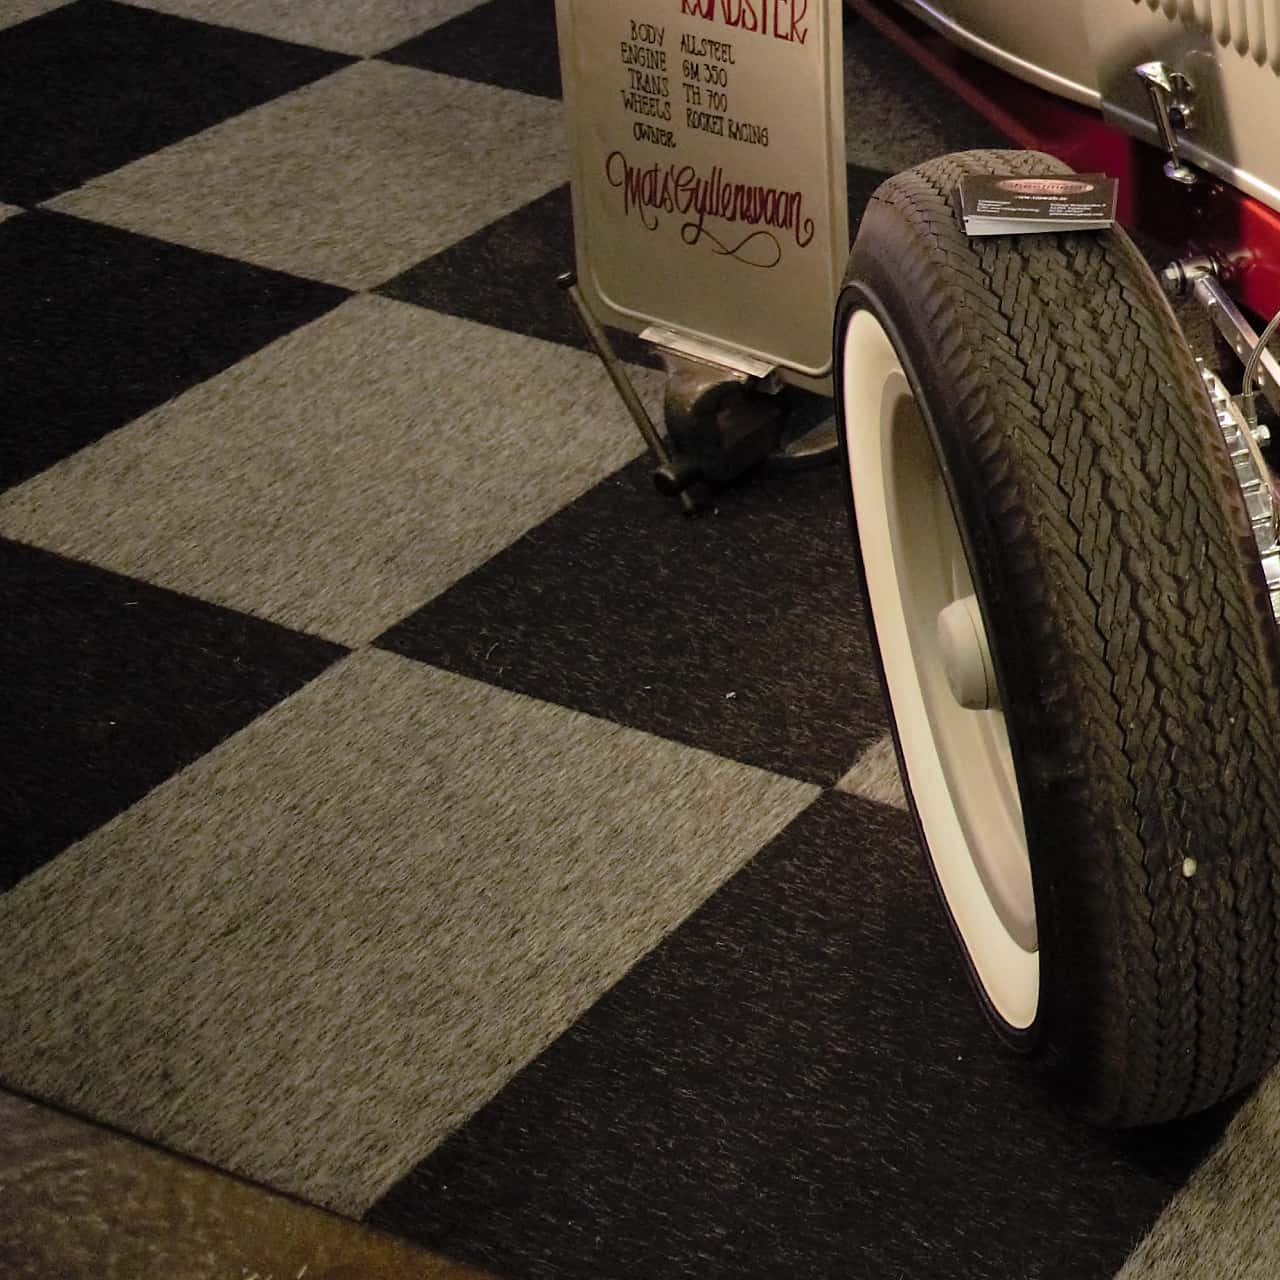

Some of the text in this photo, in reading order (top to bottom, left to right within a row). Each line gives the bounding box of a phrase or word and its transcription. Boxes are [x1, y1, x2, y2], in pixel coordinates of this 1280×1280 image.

[630, 19, 665, 47] BODY
[620, 42, 667, 72] ENGINE
[703, 63, 728, 88] 350
[620, 90, 672, 121] WHEELS
[686, 108, 725, 137] ROCKET
[628, 68, 728, 113] TRANS TH 700
[606, 151, 674, 231] Mats
